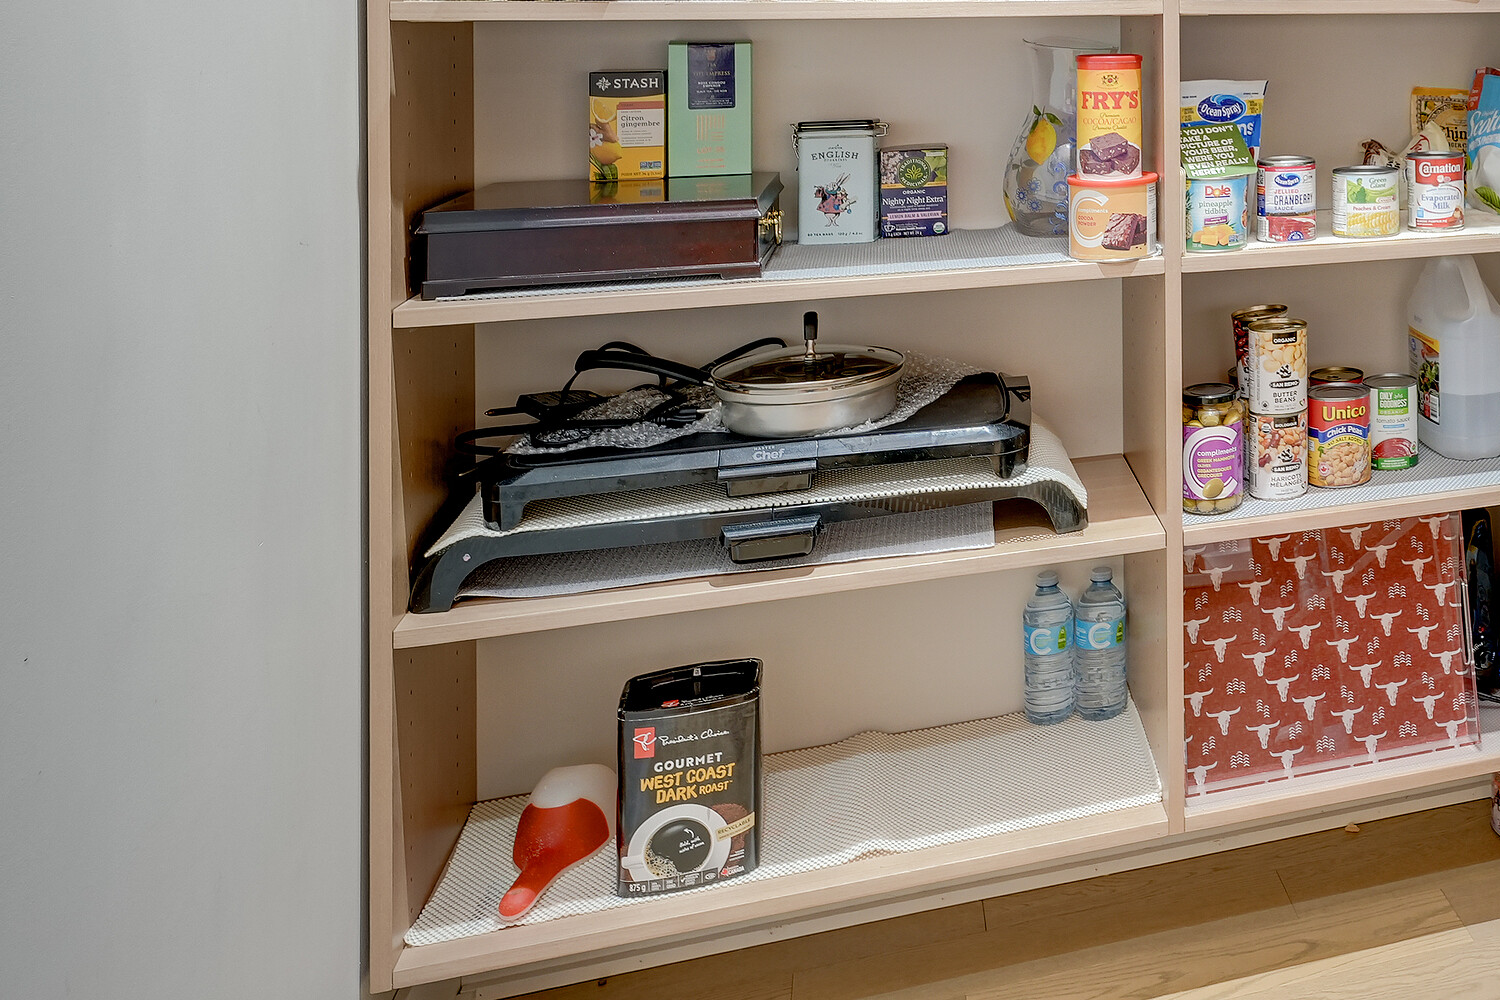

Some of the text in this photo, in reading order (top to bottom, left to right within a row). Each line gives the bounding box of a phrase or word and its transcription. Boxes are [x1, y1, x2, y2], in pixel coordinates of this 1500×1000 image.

[613, 78, 659, 89] STASH
[1081, 90, 1139, 110] FRY'S
[1200, 102, 1242, 119] Ocean Spray
[620, 120, 661, 128] gingembre
[1182, 127, 1205, 137] YOU
[1204, 124, 1234, 135] DON'T
[1180, 138, 1234, 151] PICTURE OF
[810, 151, 859, 161] ENGLISH
[1182, 145, 1239, 157] YOUR BEER,
[1184, 151, 1235, 163] WERE YOU
[1187, 156, 1250, 171] EVEN REALLY
[1418, 161, 1461, 178] Carnation
[1204, 184, 1231, 197] Dole
[881, 195, 944, 207] Nighty Night Extra
[1198, 199, 1234, 208] pineapple
[1274, 193, 1314, 206] CRANBERRY
[1421, 193, 1460, 205] Evaporated
[1204, 207, 1229, 215] tidbits
[1432, 202, 1451, 210] Milk
[1273, 336, 1297, 344] ORGANIC
[1272, 390, 1298, 398] BUTTER
[1274, 396, 1297, 404] BEANS
[1379, 391, 1394, 400] ONLY
[1379, 398, 1407, 408] GOODNESS
[1322, 405, 1366, 422] Unico
[1326, 425, 1363, 438] Chick Peas
[752, 448, 786, 461] Chef
[1196, 445, 1237, 458] compliments
[1270, 473, 1303, 483] HARICOTS
[658, 728, 731, 747] President's Choice
[653, 751, 723, 773] GOURMET
[639, 762, 736, 793] WEST COAST
[656, 780, 730, 805] DARK ROAST
[629, 883, 642, 893] 875
